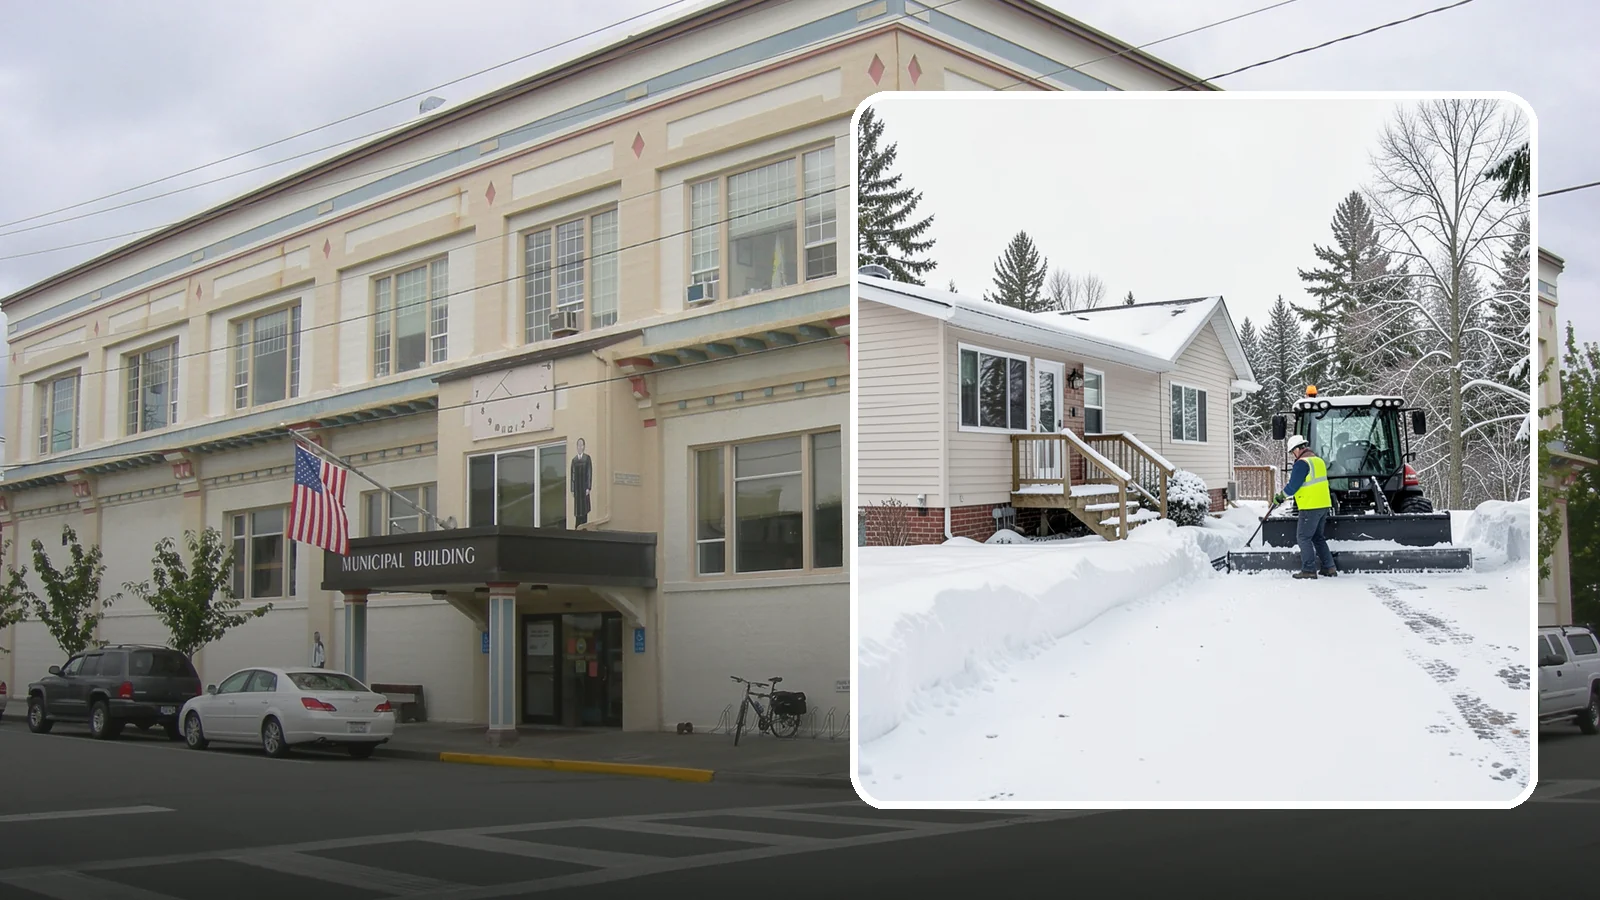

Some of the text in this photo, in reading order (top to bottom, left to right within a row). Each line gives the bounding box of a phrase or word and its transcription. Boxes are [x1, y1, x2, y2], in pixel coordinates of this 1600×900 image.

[546, 361, 552, 370] 6
[475, 390, 479, 398] 7
[480, 406, 485, 415] 8
[536, 402, 540, 410] 4
[487, 417, 493, 426] 9
[528, 413, 533, 422] 3
[494, 423, 500, 432] 10
[520, 420, 526, 428] 2
[501, 425, 506, 434] 11
[507, 425, 513, 434] 12
[342, 546, 475, 572] MUNICIPAL BUILDING
